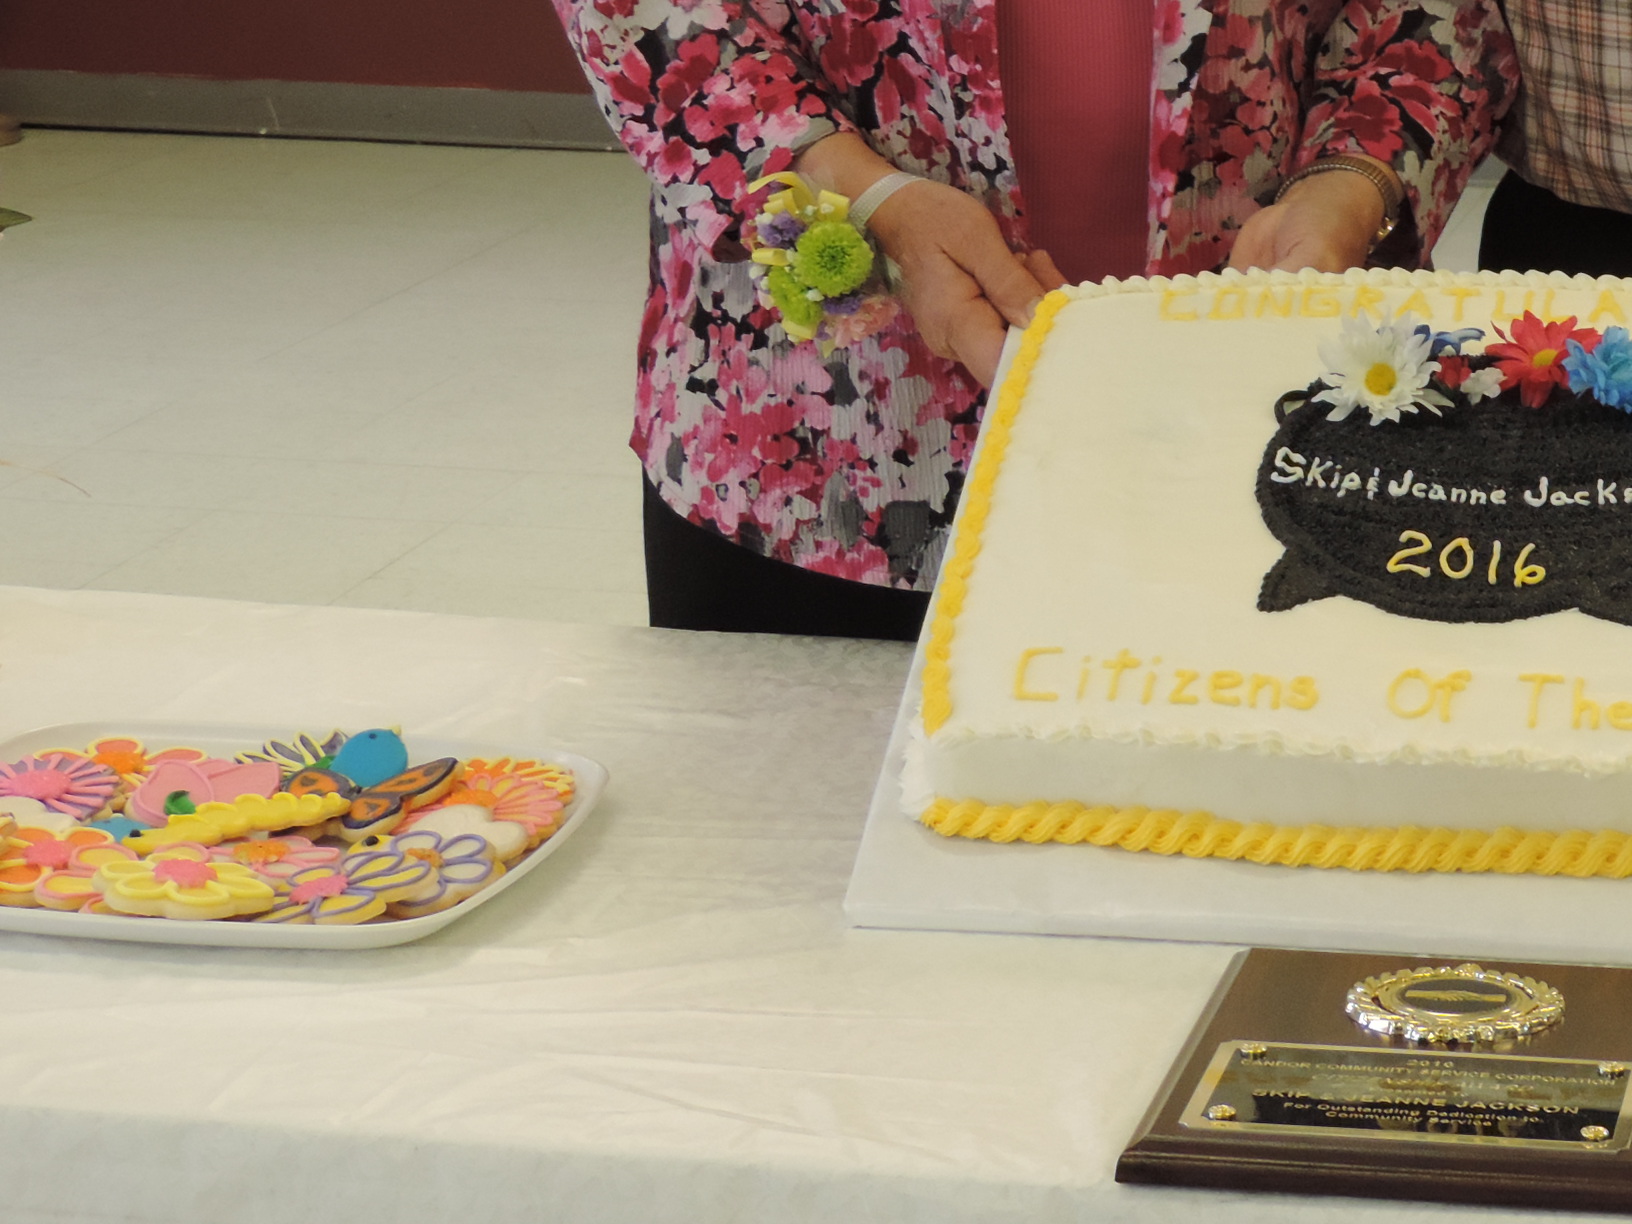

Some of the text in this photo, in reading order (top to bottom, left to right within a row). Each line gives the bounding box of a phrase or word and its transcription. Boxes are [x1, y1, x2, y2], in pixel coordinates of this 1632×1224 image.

[1387, 468, 1508, 506] Jeanne
[1385, 529, 1547, 589] 2016
[1012, 647, 1321, 711] Citizens
[1386, 668, 1473, 723] Of
[1315, 1062, 1413, 1074] COMMUNITY
[1419, 1067, 1491, 1078] SERVICE
[1495, 1071, 1617, 1086] CORPORATION
[1251, 1088, 1311, 1099] SKIP
[1343, 1093, 1449, 1106] JEANNE
[1454, 1099, 1581, 1115] JACKSON
[1283, 1101, 1312, 1110] For
[1316, 1103, 1421, 1117] Outstanding
[1425, 1108, 1518, 1121] Dedication
[1324, 1110, 1493, 1126] Community Service
